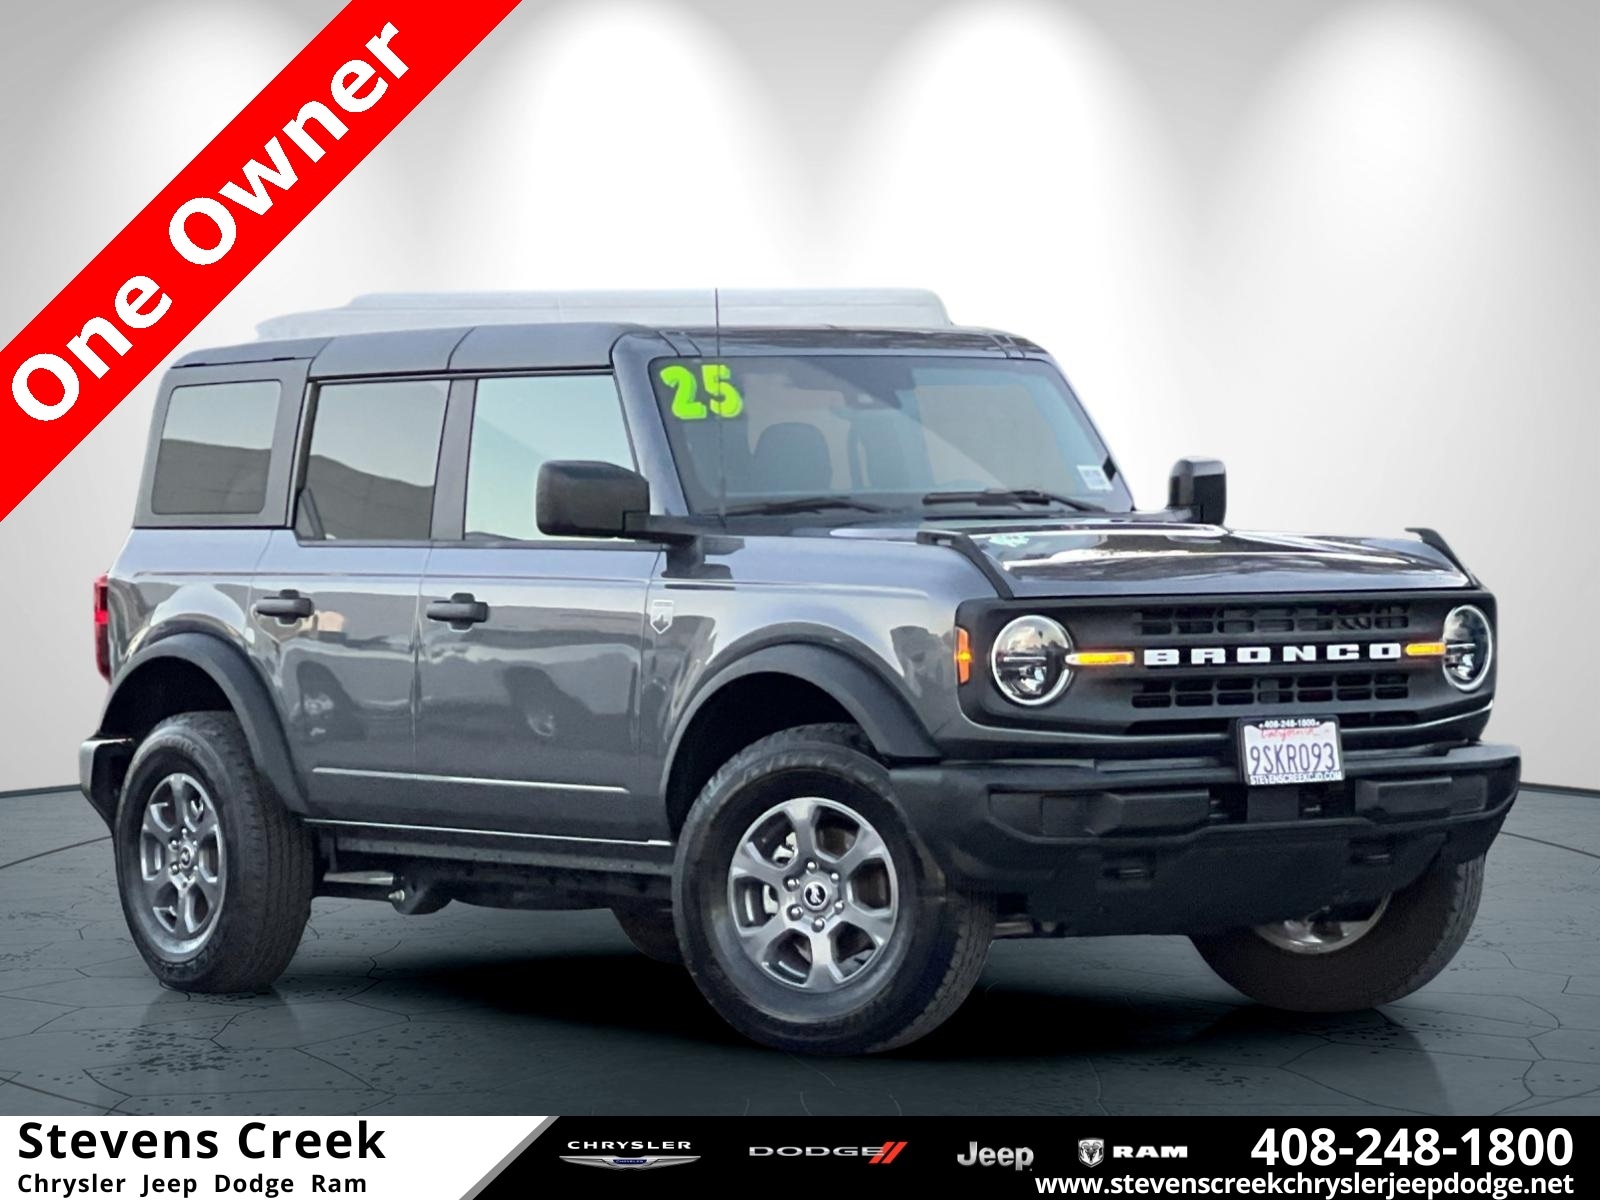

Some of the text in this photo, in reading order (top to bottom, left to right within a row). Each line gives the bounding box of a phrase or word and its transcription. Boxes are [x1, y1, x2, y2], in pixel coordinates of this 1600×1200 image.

[660, 364, 743, 419] 25
[1143, 642, 1402, 666] BRONCO
[1250, 742, 1336, 776] 9SKR093
